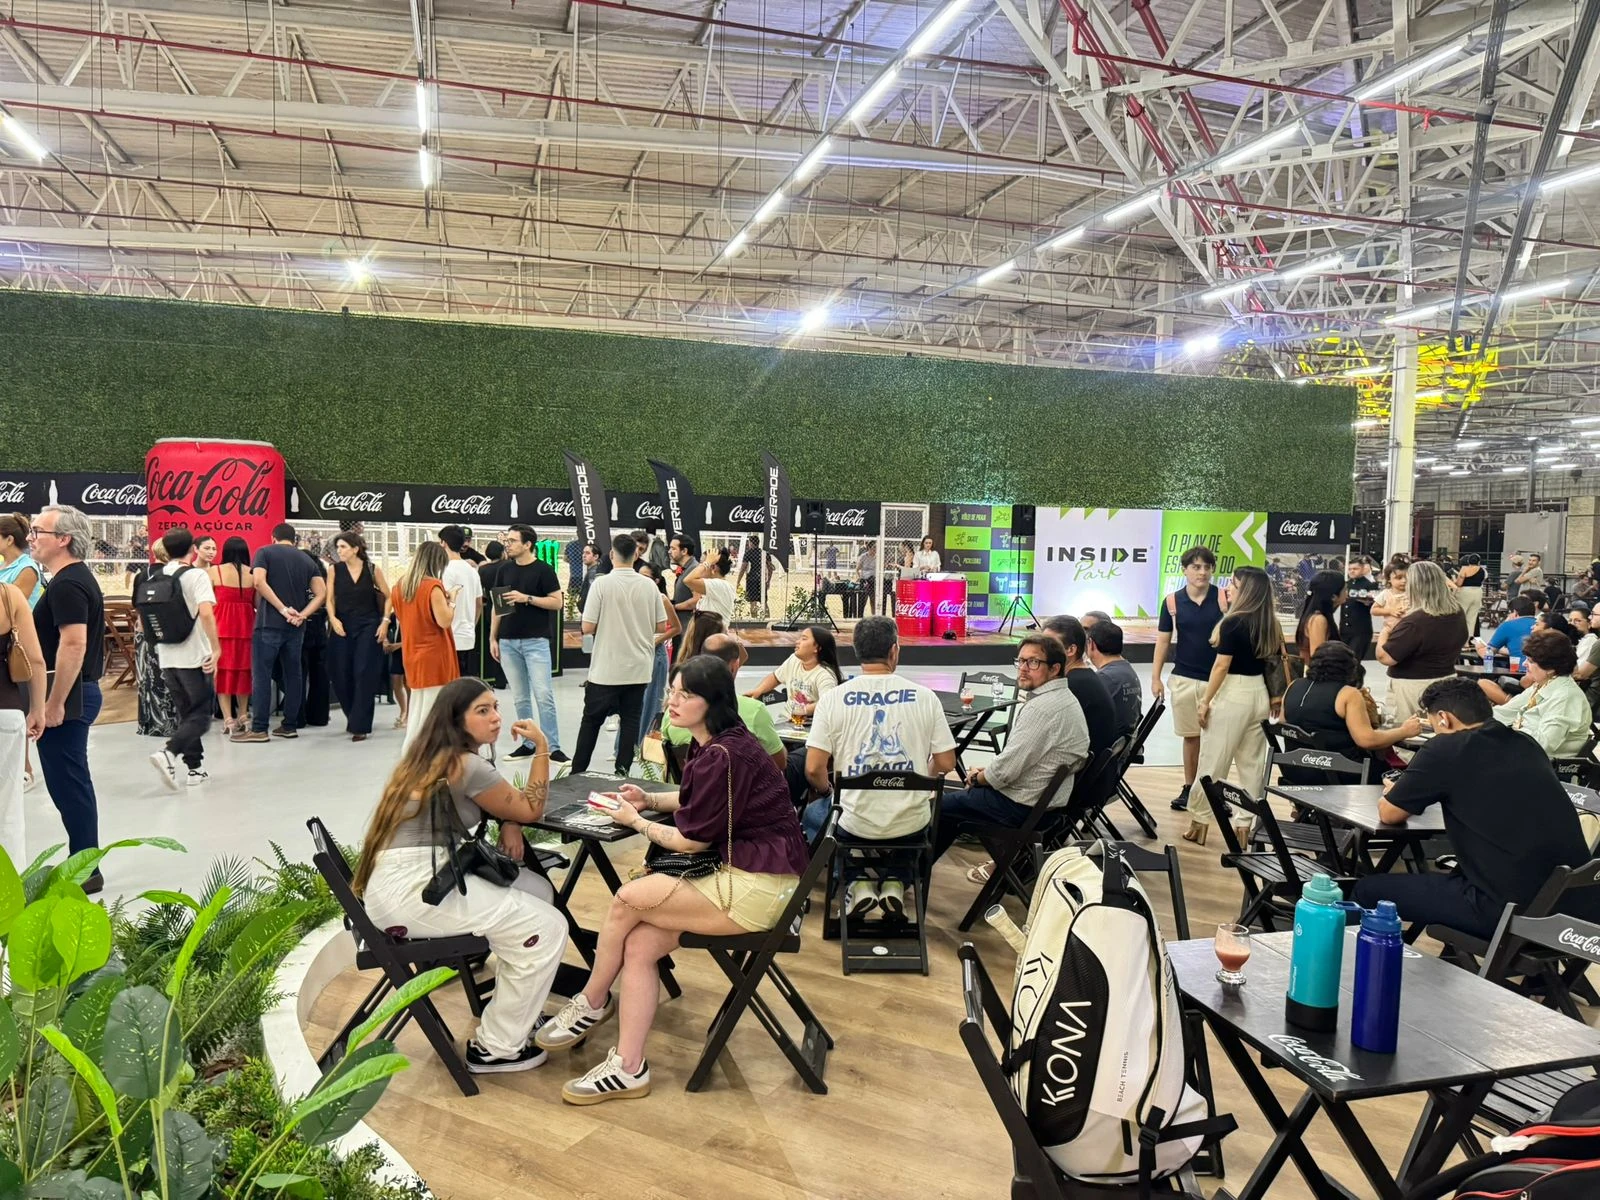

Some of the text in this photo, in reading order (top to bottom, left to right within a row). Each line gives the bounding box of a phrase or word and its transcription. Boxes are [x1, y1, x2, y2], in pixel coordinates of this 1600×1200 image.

[81, 483, 147, 505] Coca-Cola
[147, 457, 275, 516] Coca-Cola
[320, 490, 387, 512] Coca-Cola
[431, 494, 494, 515] Coca-Cola
[666, 478, 684, 536] ERADE
[769, 466, 779, 550] POWERADE
[159, 520, 253, 532] ZERO AÇÚCAR
[825, 508, 868, 527] ca-Cola
[1280, 520, 1320, 536] Coca-Cola
[1168, 534, 1178, 552] O
[1208, 535, 1223, 553] DE
[1047, 547, 1148, 563] INSIDE
[1219, 556, 1235, 574] DO
[1073, 559, 1122, 581] Park
[843, 689, 916, 706] GRACIE
[1302, 754, 1333, 767] Coca-Cola
[873, 776, 905, 787] Coca-Cola
[1559, 927, 1600, 956] Coca-Co
[1268, 1034, 1365, 1083] Coca-Cola
[1116, 1051, 1129, 1103] BEACH TENNIS
